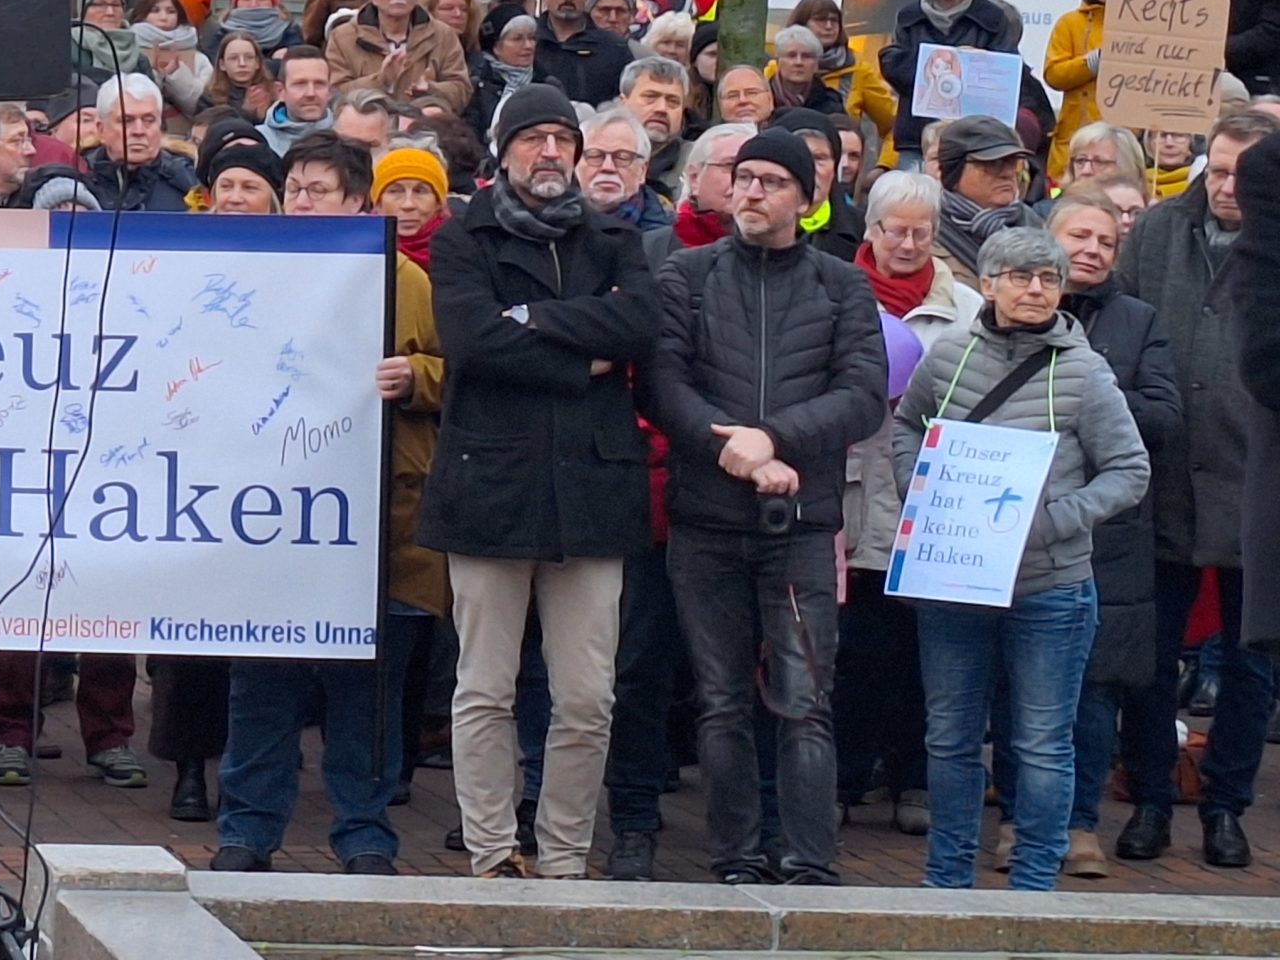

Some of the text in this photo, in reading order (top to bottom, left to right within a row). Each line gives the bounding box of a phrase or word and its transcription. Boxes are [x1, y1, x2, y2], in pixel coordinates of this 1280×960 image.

[1111, 35, 1200, 62] wird nur
[1104, 67, 1222, 109] gestrickt!
[280, 415, 354, 467] Momo
[948, 439, 1012, 463] Unser
[938, 463, 1003, 487] Kreuz
[929, 490, 965, 511] hat
[922, 516, 980, 539] keine
[915, 543, 984, 568] Haken
[150, 616, 307, 644] Kirchenkreis
[315, 620, 377, 645] Unna
